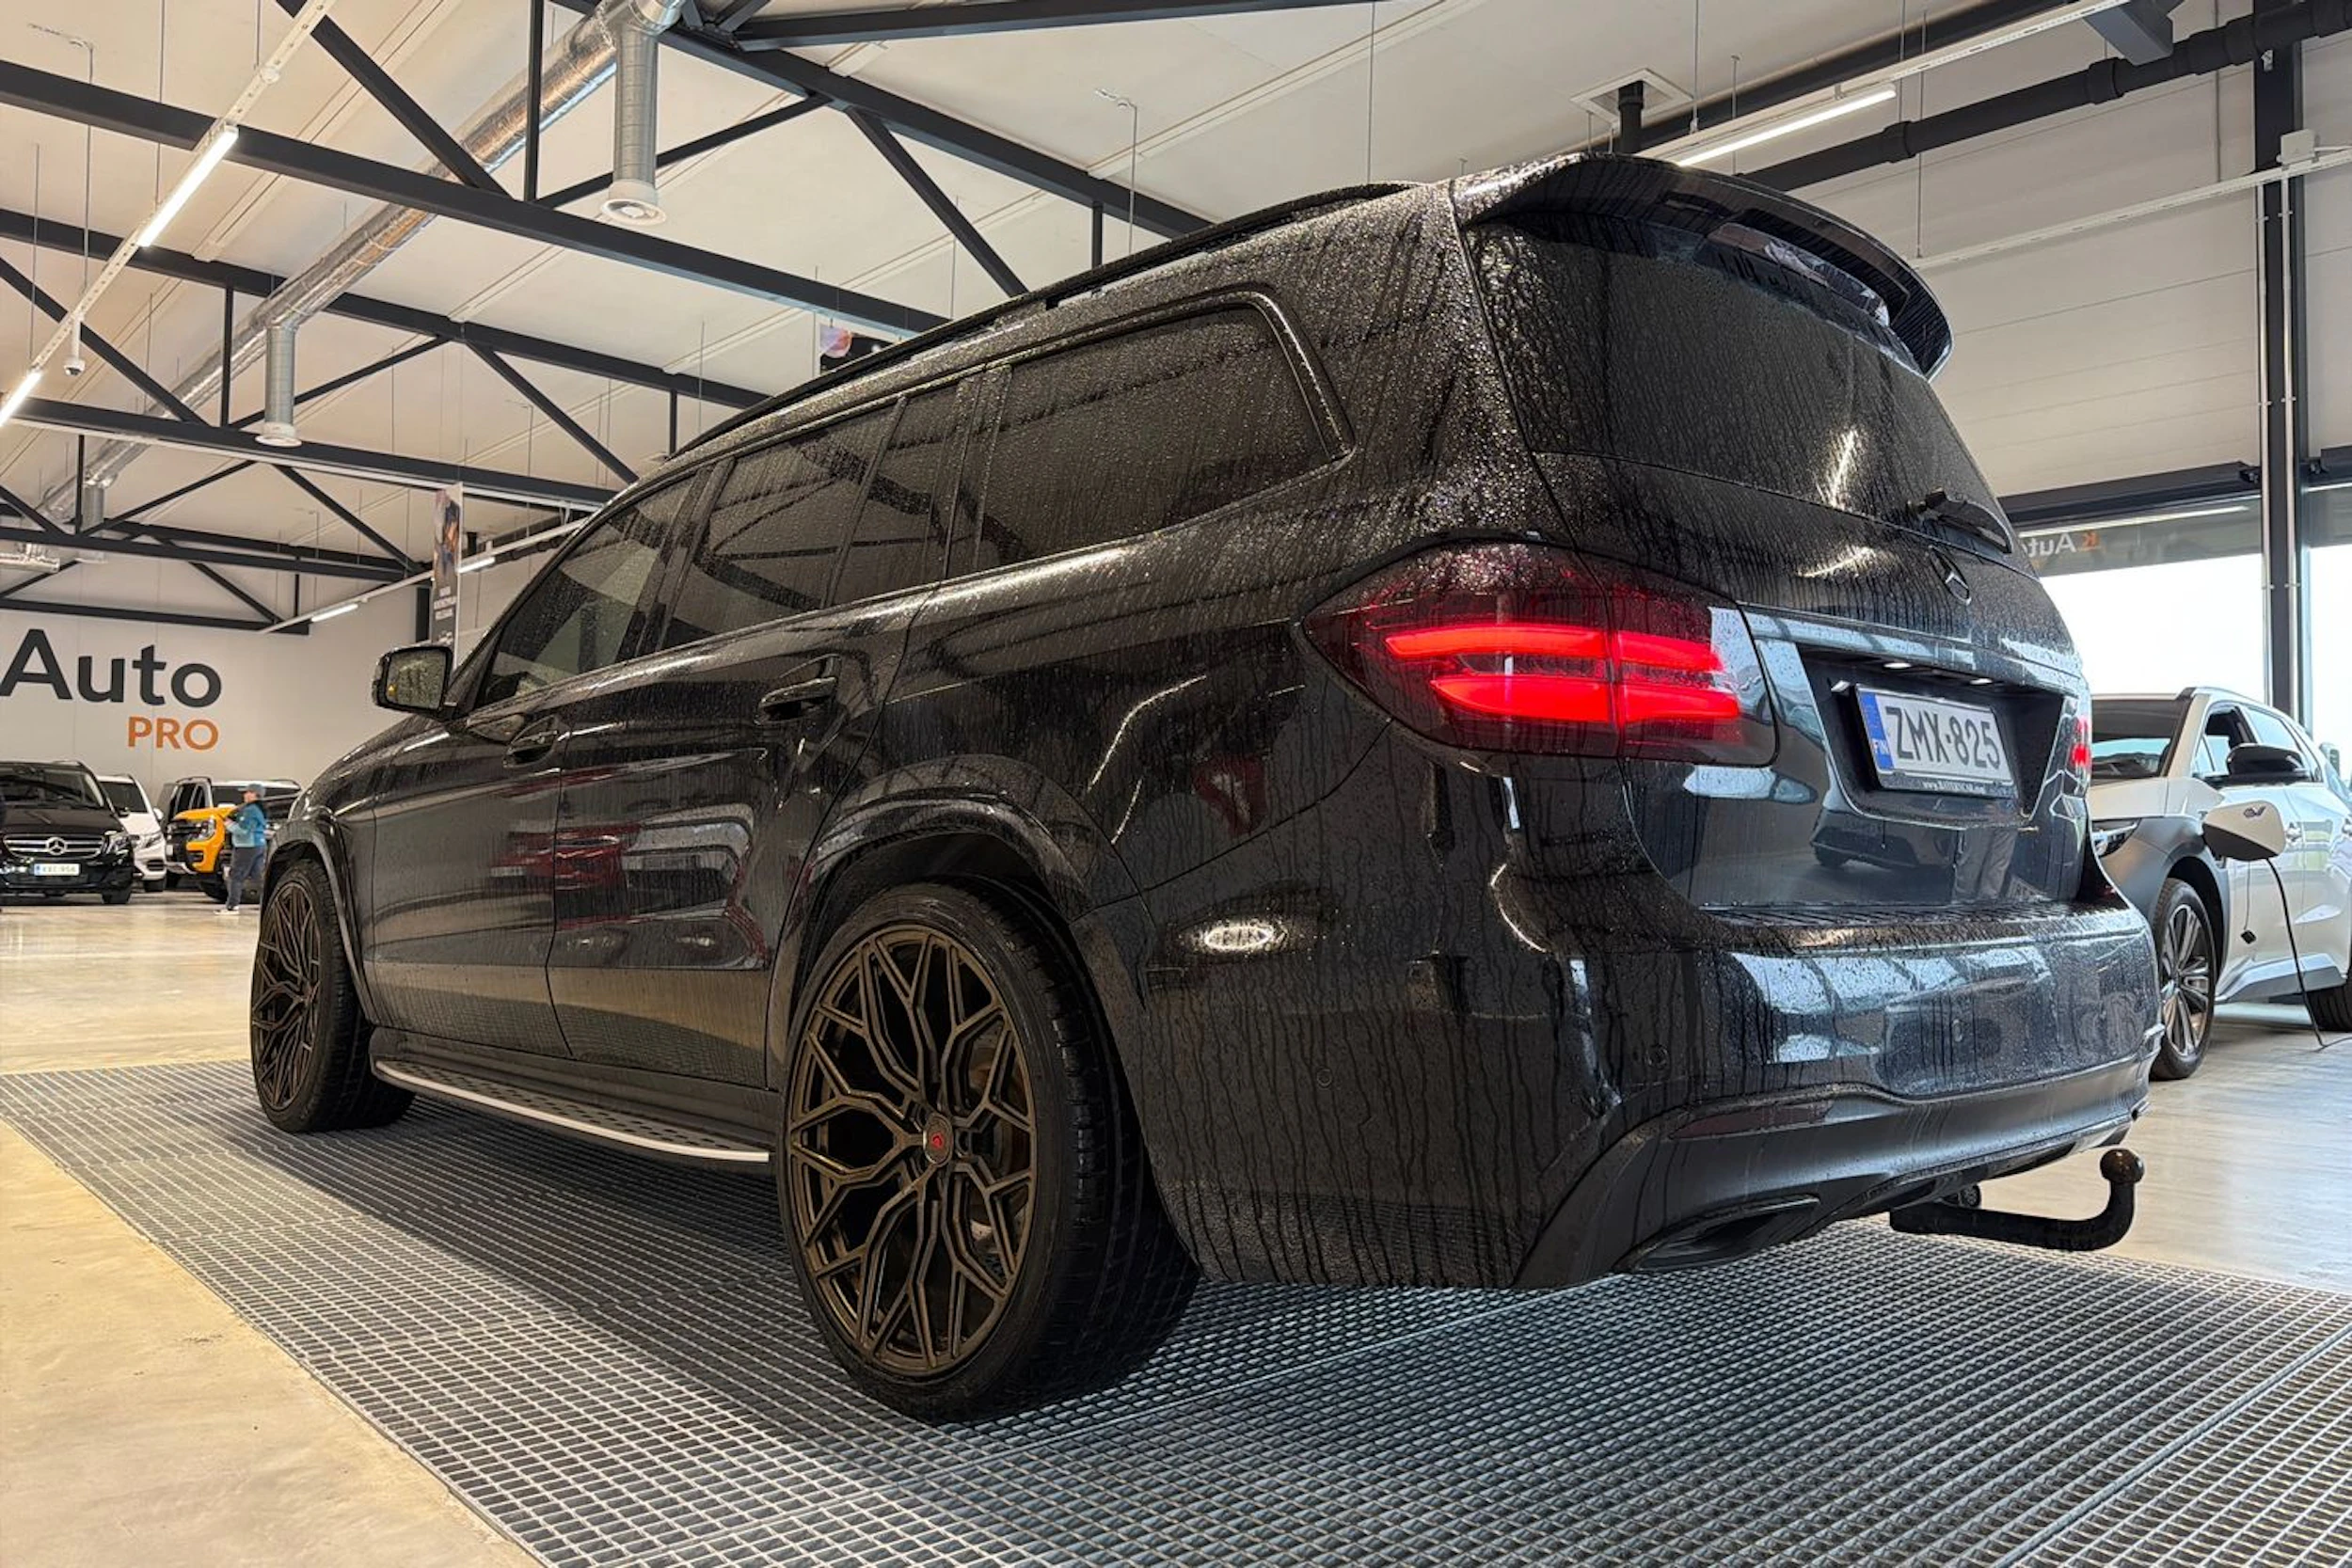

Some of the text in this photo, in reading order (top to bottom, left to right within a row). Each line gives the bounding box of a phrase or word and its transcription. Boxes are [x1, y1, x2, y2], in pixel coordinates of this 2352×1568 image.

[0, 628, 222, 707] Auto
[128, 716, 219, 751] PRO
[1884, 705, 2002, 770] ZMX-825
